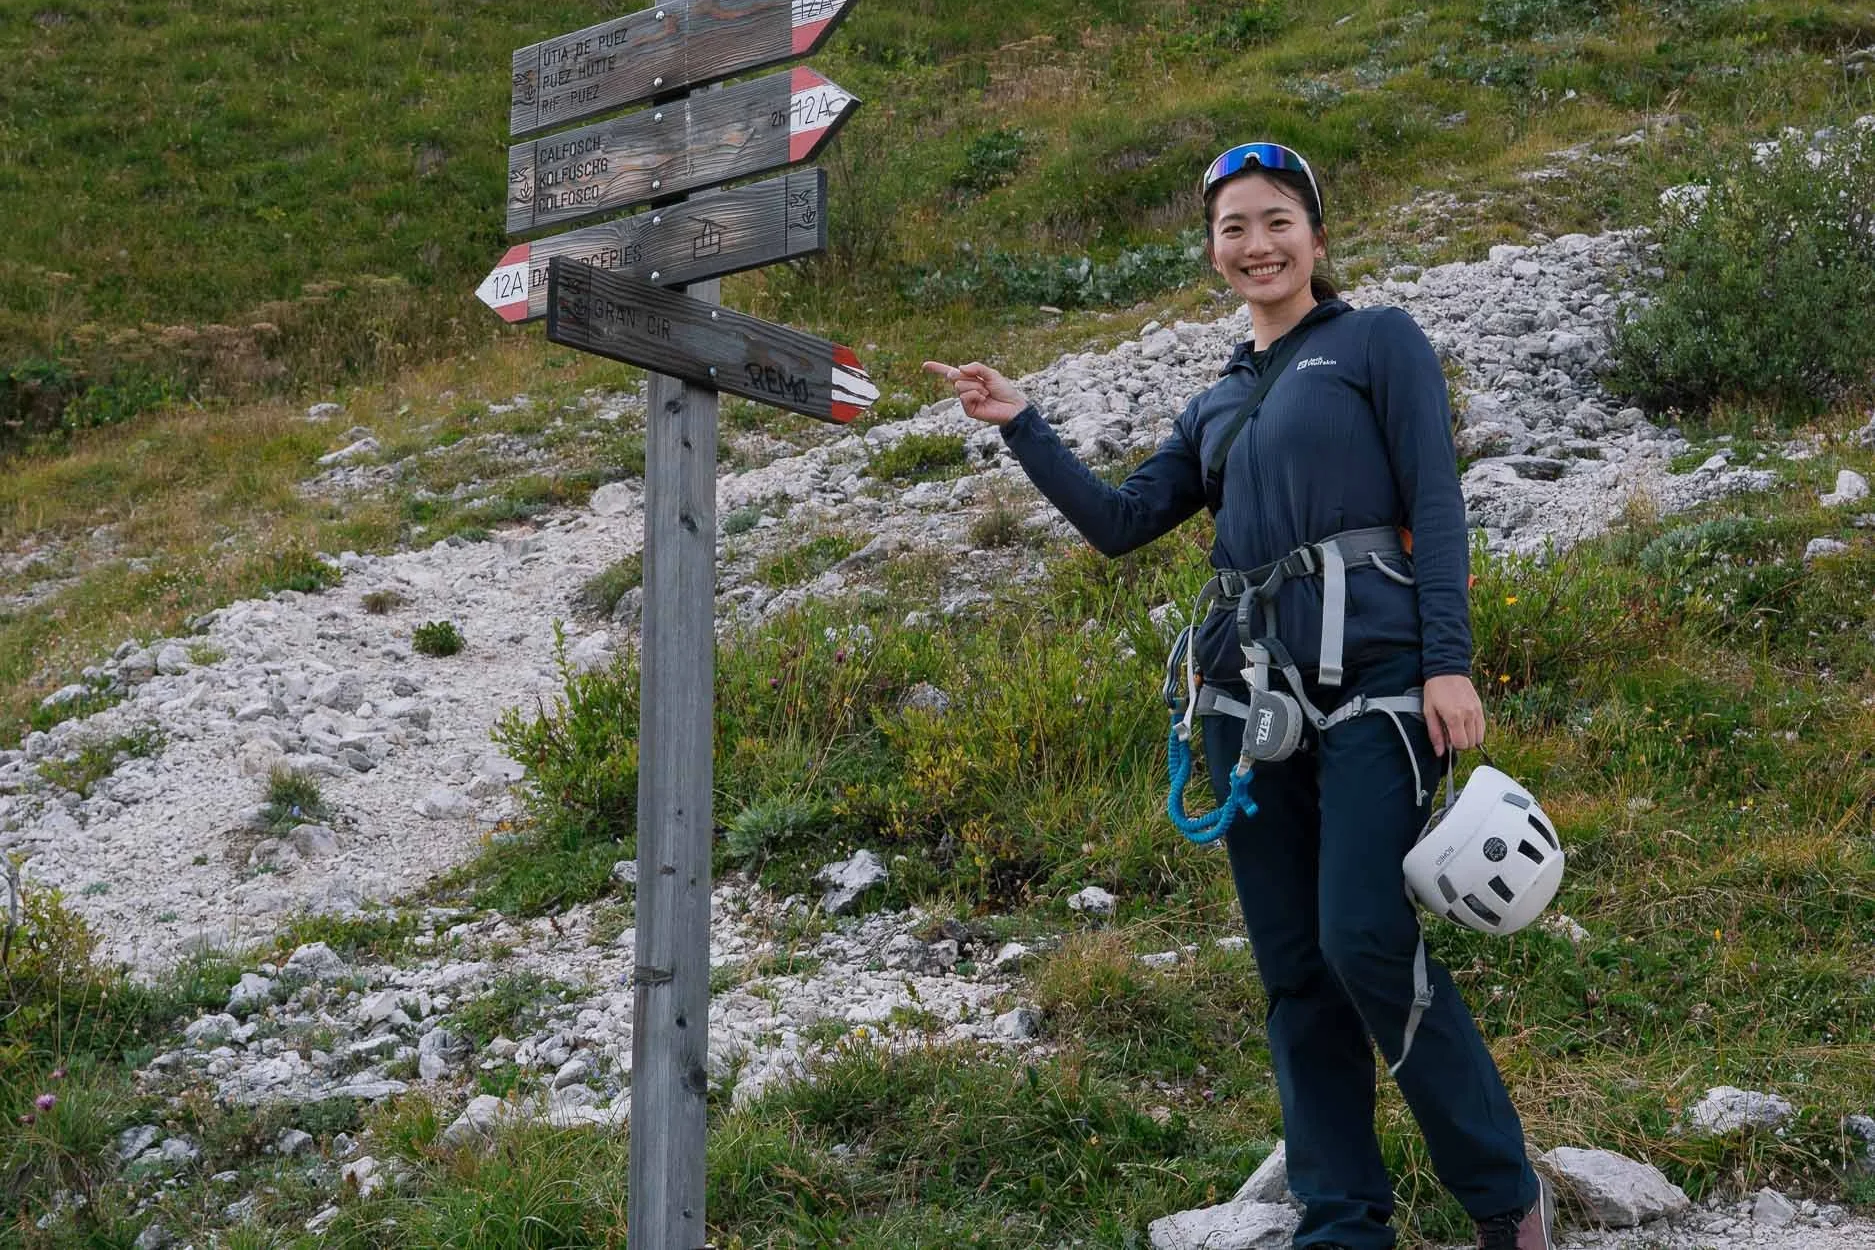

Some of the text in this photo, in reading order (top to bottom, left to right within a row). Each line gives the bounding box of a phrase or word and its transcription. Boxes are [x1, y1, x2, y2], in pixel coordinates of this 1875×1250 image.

[575, 39, 592, 56] DE
[598, 28, 629, 50] PUEZ
[543, 69, 572, 90] PUEZ
[570, 84, 599, 105] PUEZ
[771, 92, 832, 127] 2h 12A
[540, 135, 601, 164] CALFOSCH
[540, 157, 608, 189] KOLFUSCHG
[538, 185, 599, 213] COLFOSCO
[493, 270, 524, 299] 12A
[594, 299, 672, 341] GRAN CIR
[1256, 709, 1273, 745] PETZL
